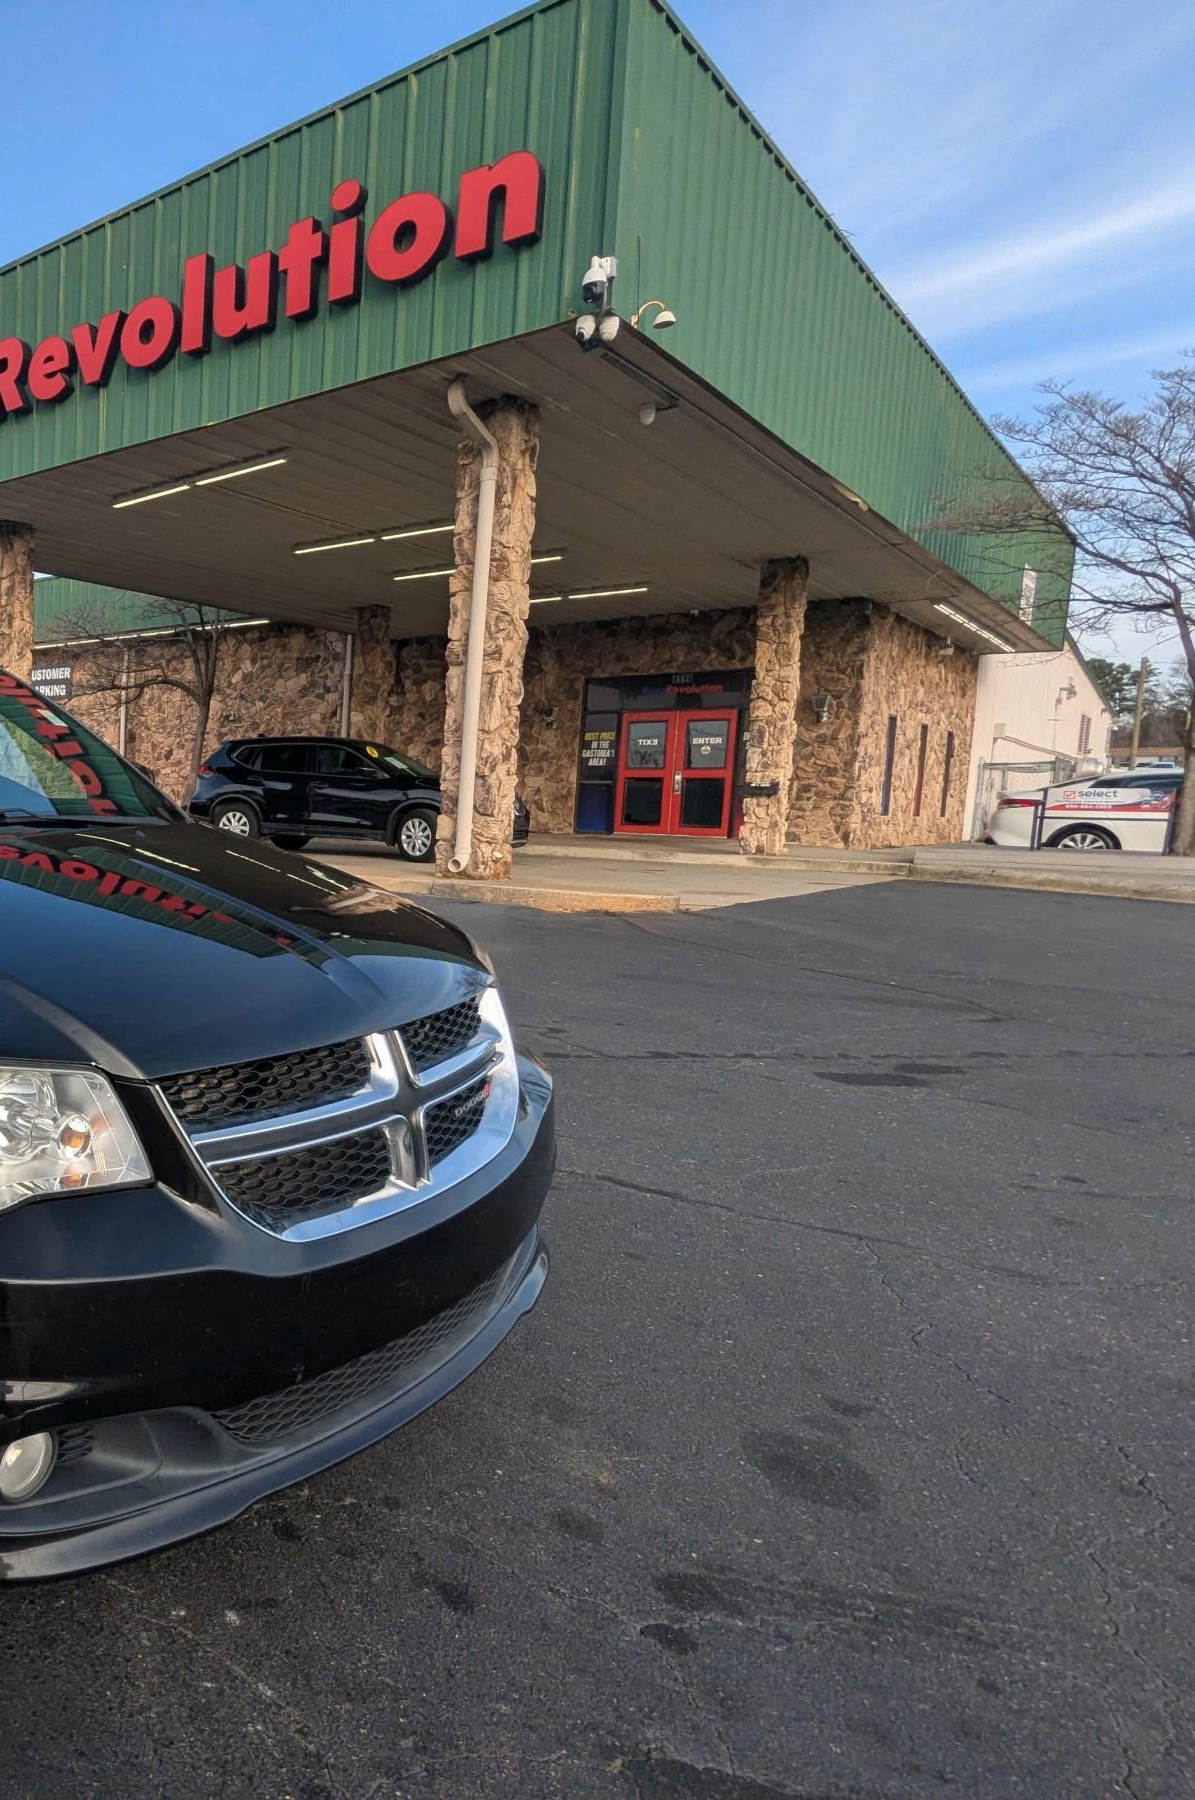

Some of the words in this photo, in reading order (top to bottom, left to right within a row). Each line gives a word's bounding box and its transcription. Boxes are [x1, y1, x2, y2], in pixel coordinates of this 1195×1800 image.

[31, 667, 71, 681] USTOMER
[35, 684, 66, 697] RKING
[599, 740, 611, 749] THE
[692, 737, 723, 745] ENTER
[588, 757, 608, 766] AREA!
[1077, 789, 1119, 798] select
